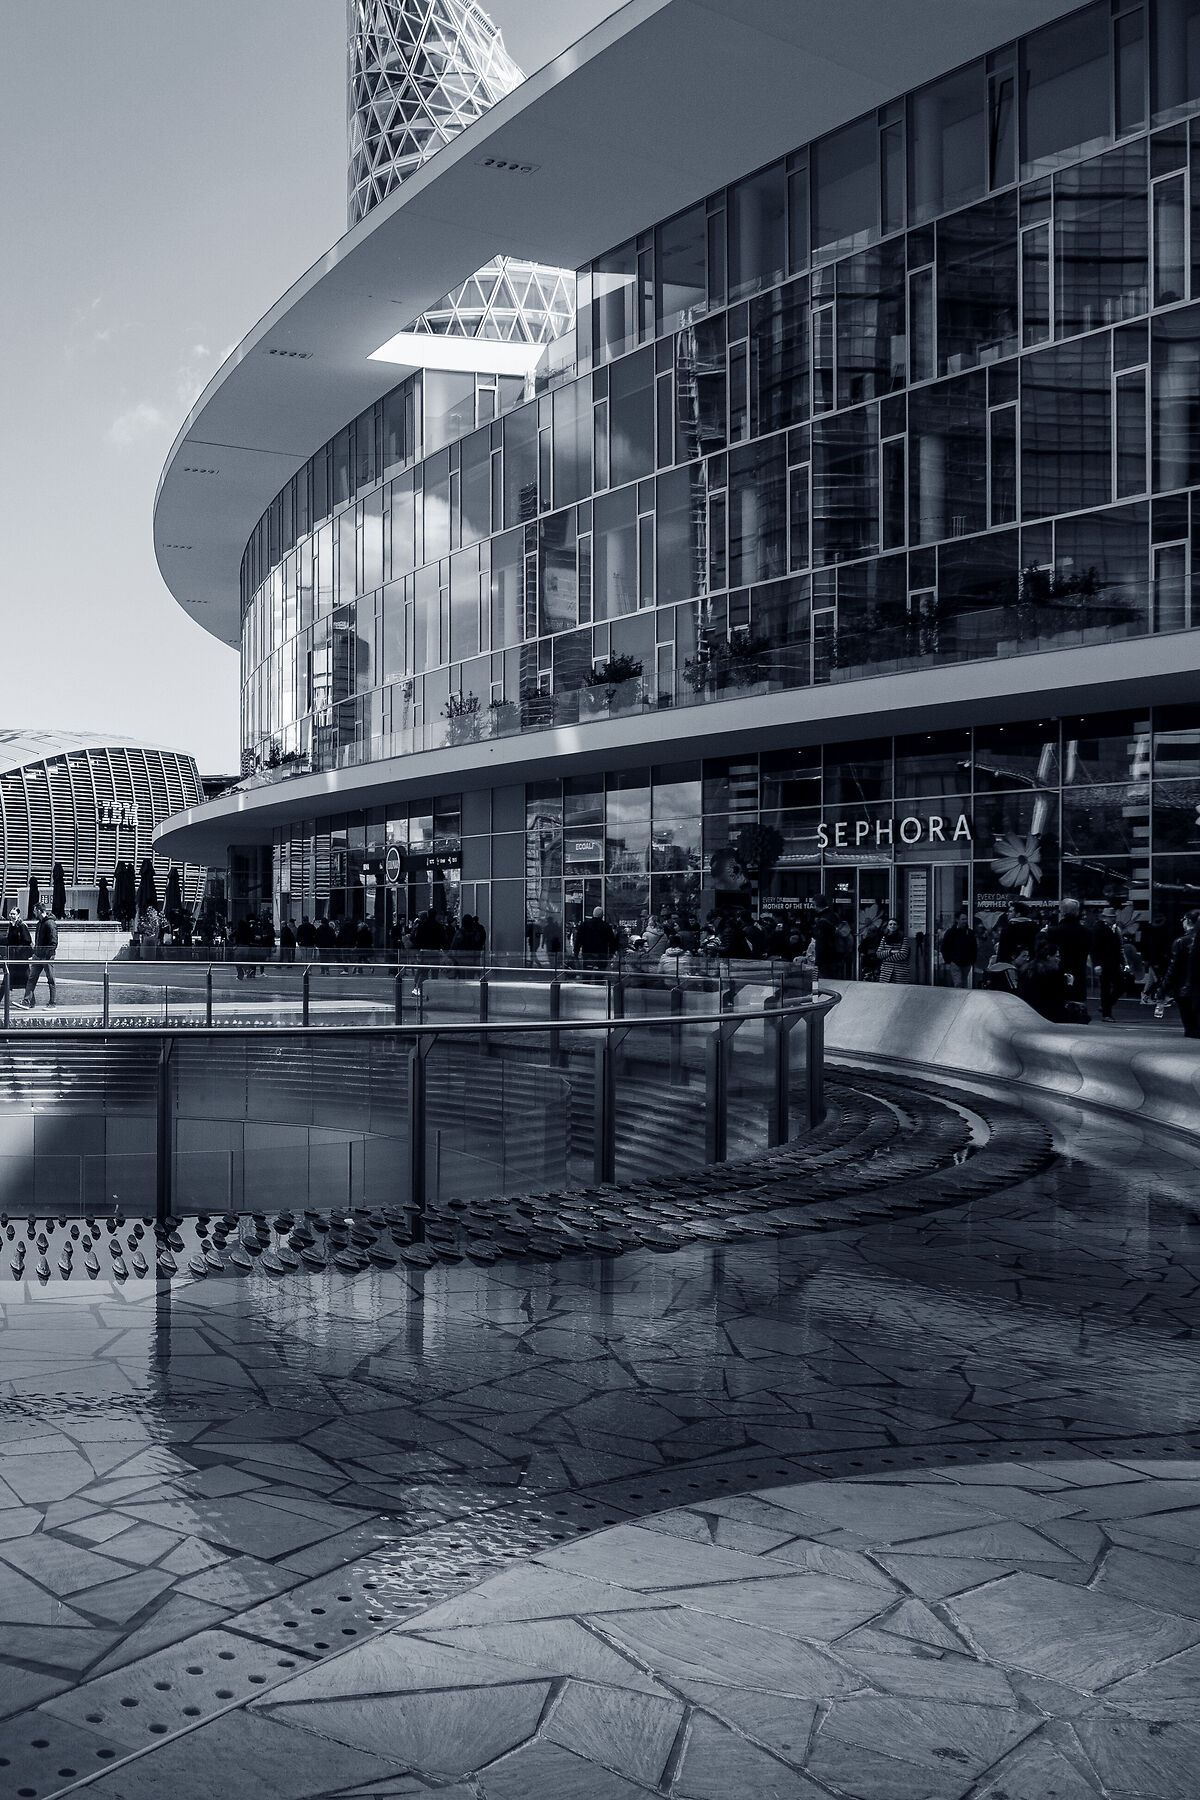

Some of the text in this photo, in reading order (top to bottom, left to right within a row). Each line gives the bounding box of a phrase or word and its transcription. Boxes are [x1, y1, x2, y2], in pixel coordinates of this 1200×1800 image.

[102, 801, 138, 826] IBM
[817, 814, 972, 848] SEPHORA
[977, 900, 1007, 908] MOTHER
